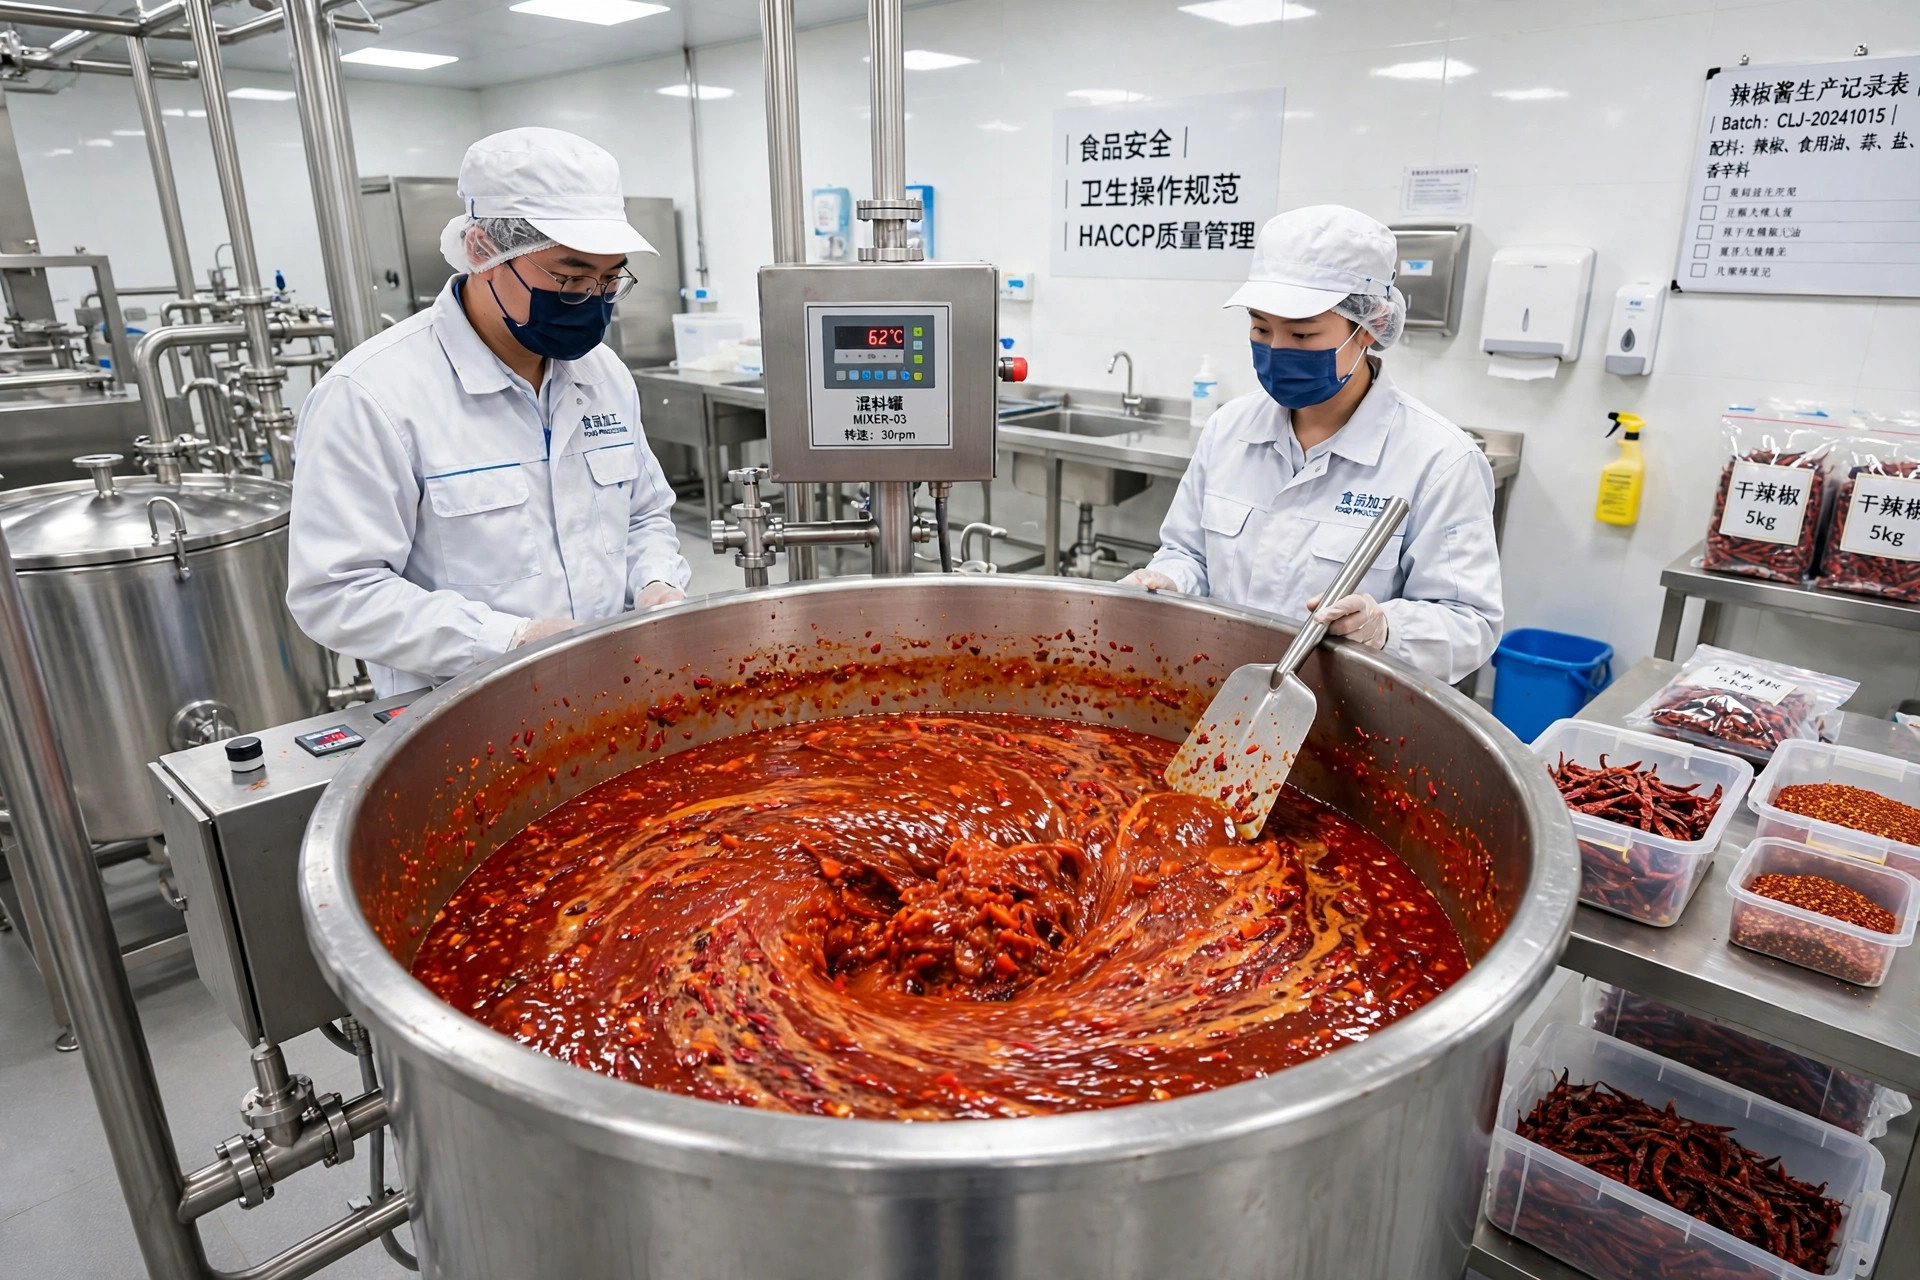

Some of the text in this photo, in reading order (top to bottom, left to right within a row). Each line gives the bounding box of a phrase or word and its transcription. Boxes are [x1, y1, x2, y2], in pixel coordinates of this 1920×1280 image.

[1730, 72, 1910, 107] 辣椒酱生产记录表
[1777, 107, 1886, 128] CLJ-20241015
[1080, 128, 1172, 162] 食品安全
[1706, 161, 1750, 179] 香辛料
[1080, 172, 1241, 207] 卫生操作规范
[1079, 220, 1255, 250] HACCP质量管理
[856, 395, 904, 412] 混料罐
[581, 413, 622, 430] 食加工
[853, 414, 907, 424] MIXER-03
[1735, 481, 1800, 506] 干辣椒
[1858, 494, 1920, 521] 干辣椒
[1745, 510, 1777, 531] 5kg
[1869, 524, 1906, 547] 5kg
